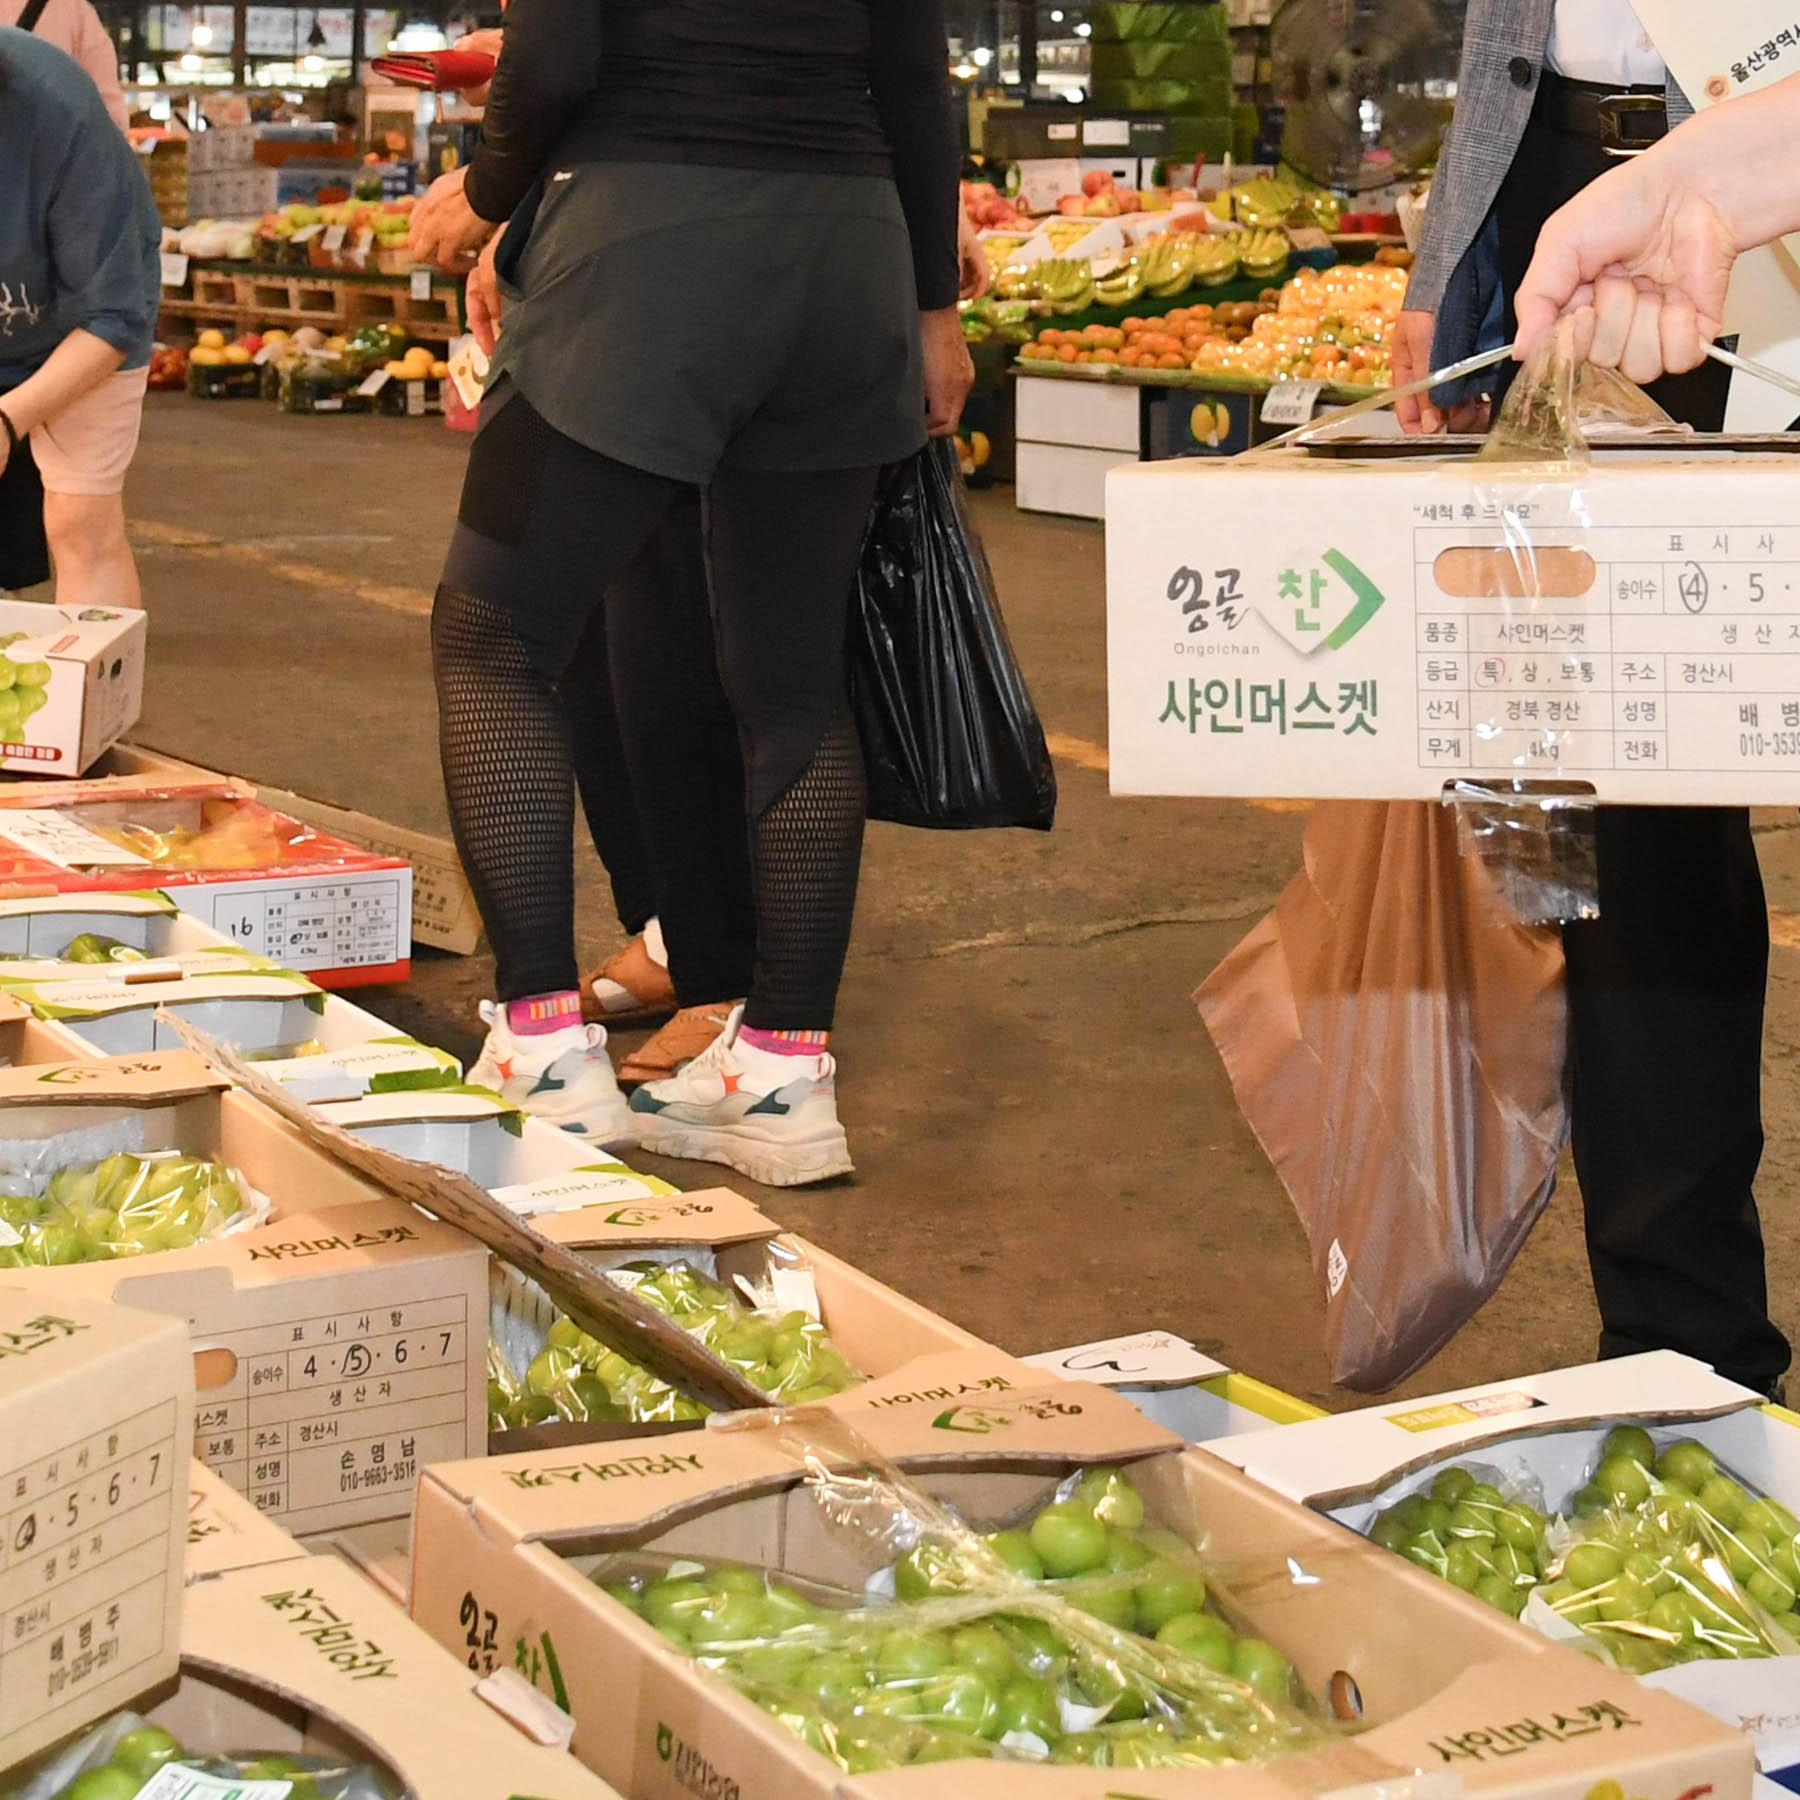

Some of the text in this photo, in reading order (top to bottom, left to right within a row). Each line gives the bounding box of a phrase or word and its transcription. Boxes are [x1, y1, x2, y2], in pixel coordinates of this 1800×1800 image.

[1460, 503, 1476, 520] 후
[1617, 579, 1657, 600] 송이수
[1749, 572, 1765, 603] 5
[1424, 621, 1585, 644] 품종 샤인머스켓
[1173, 642, 1261, 659] Ongolchan
[1425, 661, 1460, 681] 등급
[1560, 661, 1595, 682] 보통
[1621, 662, 1734, 684] 주소 경산시
[1157, 677, 1378, 737] 샤인머스켓
[1425, 700, 1581, 722] 산지 경북 경산
[1622, 700, 1657, 722] 성명
[1427, 737, 1461, 759] 무게
[1622, 741, 1658, 761] 전화
[247, 1225, 421, 1262] 샤인머스켓
[252, 1364, 284, 1385] 송이수
[303, 1355, 318, 1379] 4
[394, 1339, 408, 1364] 6
[439, 1332, 452, 1357] 7
[207, 1421, 339, 1456] 보통 주소 경산시
[255, 1459, 281, 1480] 성명
[501, 1454, 705, 1490] 샤인머스켓
[254, 1490, 281, 1511] 전화
[260, 1587, 399, 1681] 샤인머스켓
[1426, 1699, 1643, 1764] 샤인머스켓
